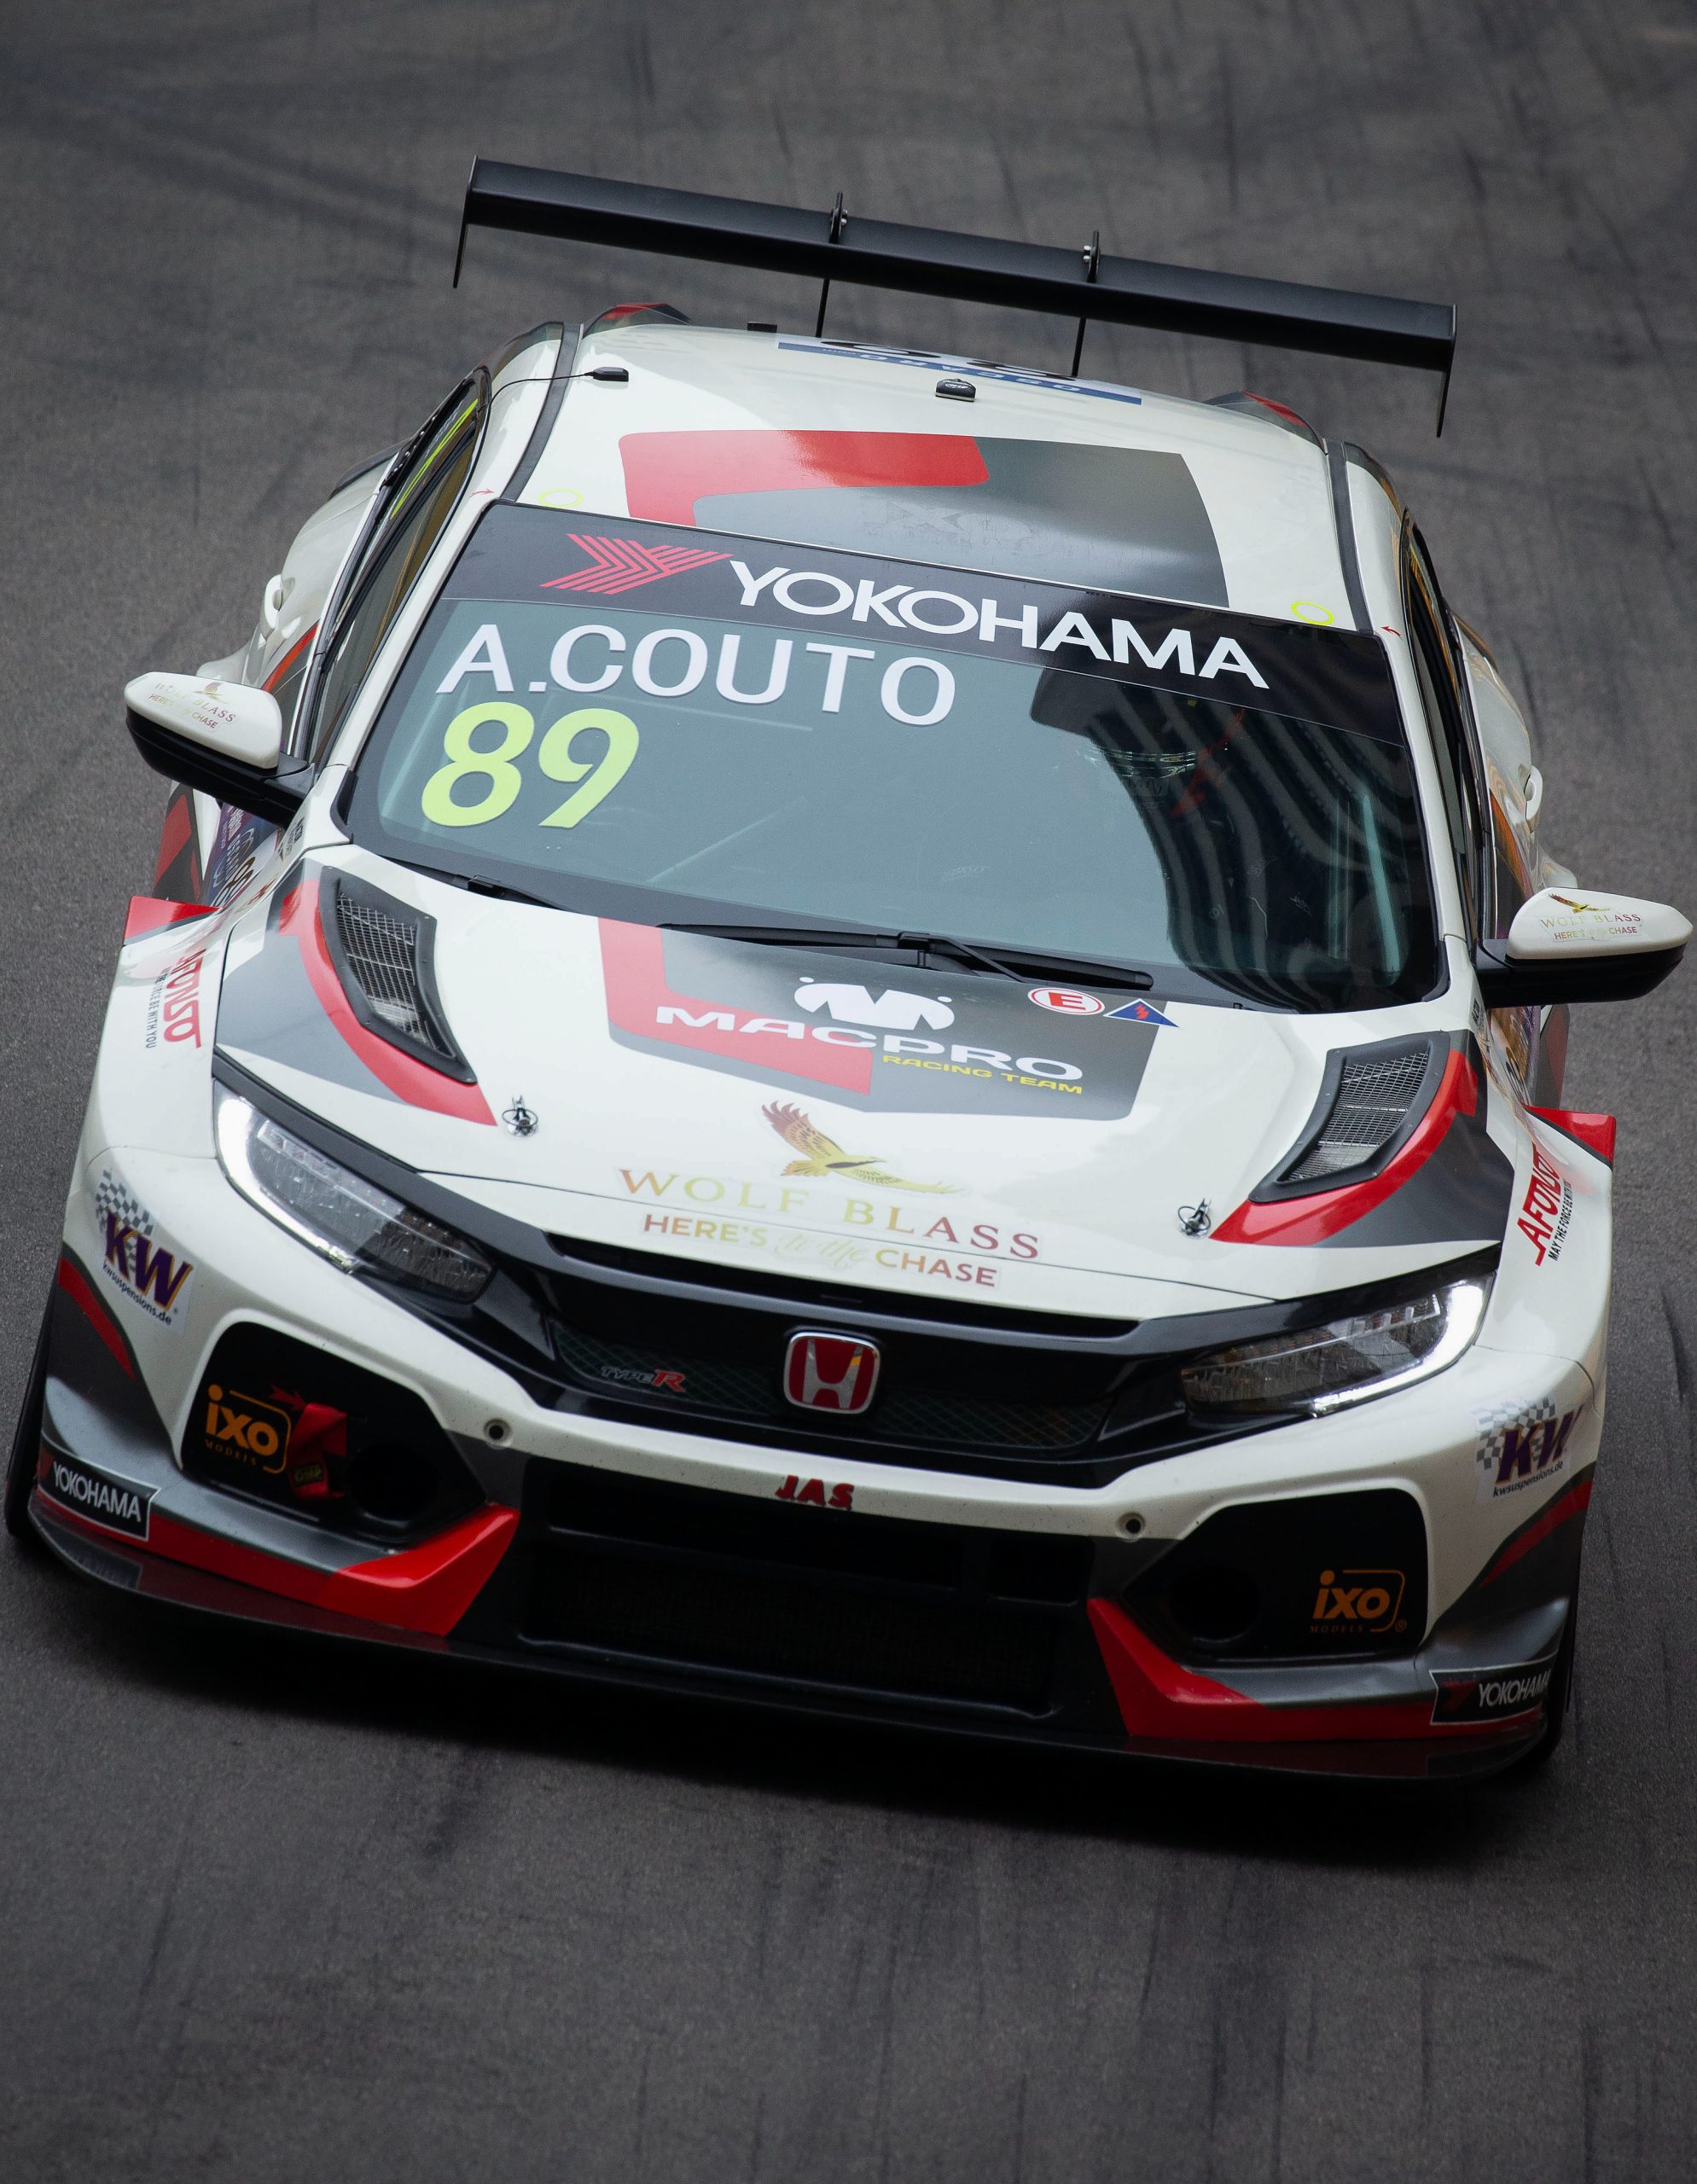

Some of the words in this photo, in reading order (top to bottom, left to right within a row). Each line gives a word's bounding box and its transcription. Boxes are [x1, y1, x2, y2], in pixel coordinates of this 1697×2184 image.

[728, 559, 1270, 689] YOKOHAMA
[435, 624, 956, 726] A.COUTO
[421, 700, 640, 828] 89
[1593, 914, 1642, 923] BLASS
[1608, 926, 1638, 935] CHASE
[145, 1029, 158, 1049] YOU
[655, 1005, 1083, 1081] MACPRO
[882, 1054, 993, 1078] RACING
[999, 1072, 1083, 1095] TEAM
[619, 1169, 811, 1213] WOLF
[841, 1198, 1039, 1258] BLASS
[1555, 1224, 1567, 1243] THE
[1559, 1205, 1572, 1228] FORCE
[105, 1208, 195, 1311] KW
[643, 1214, 768, 1248] HERE'S
[875, 1250, 997, 1287] CHASE
[1548, 1240, 1562, 1261] MAY
[53, 1461, 142, 1523] YOKOHAMA
[775, 1474, 854, 1510] JAS
